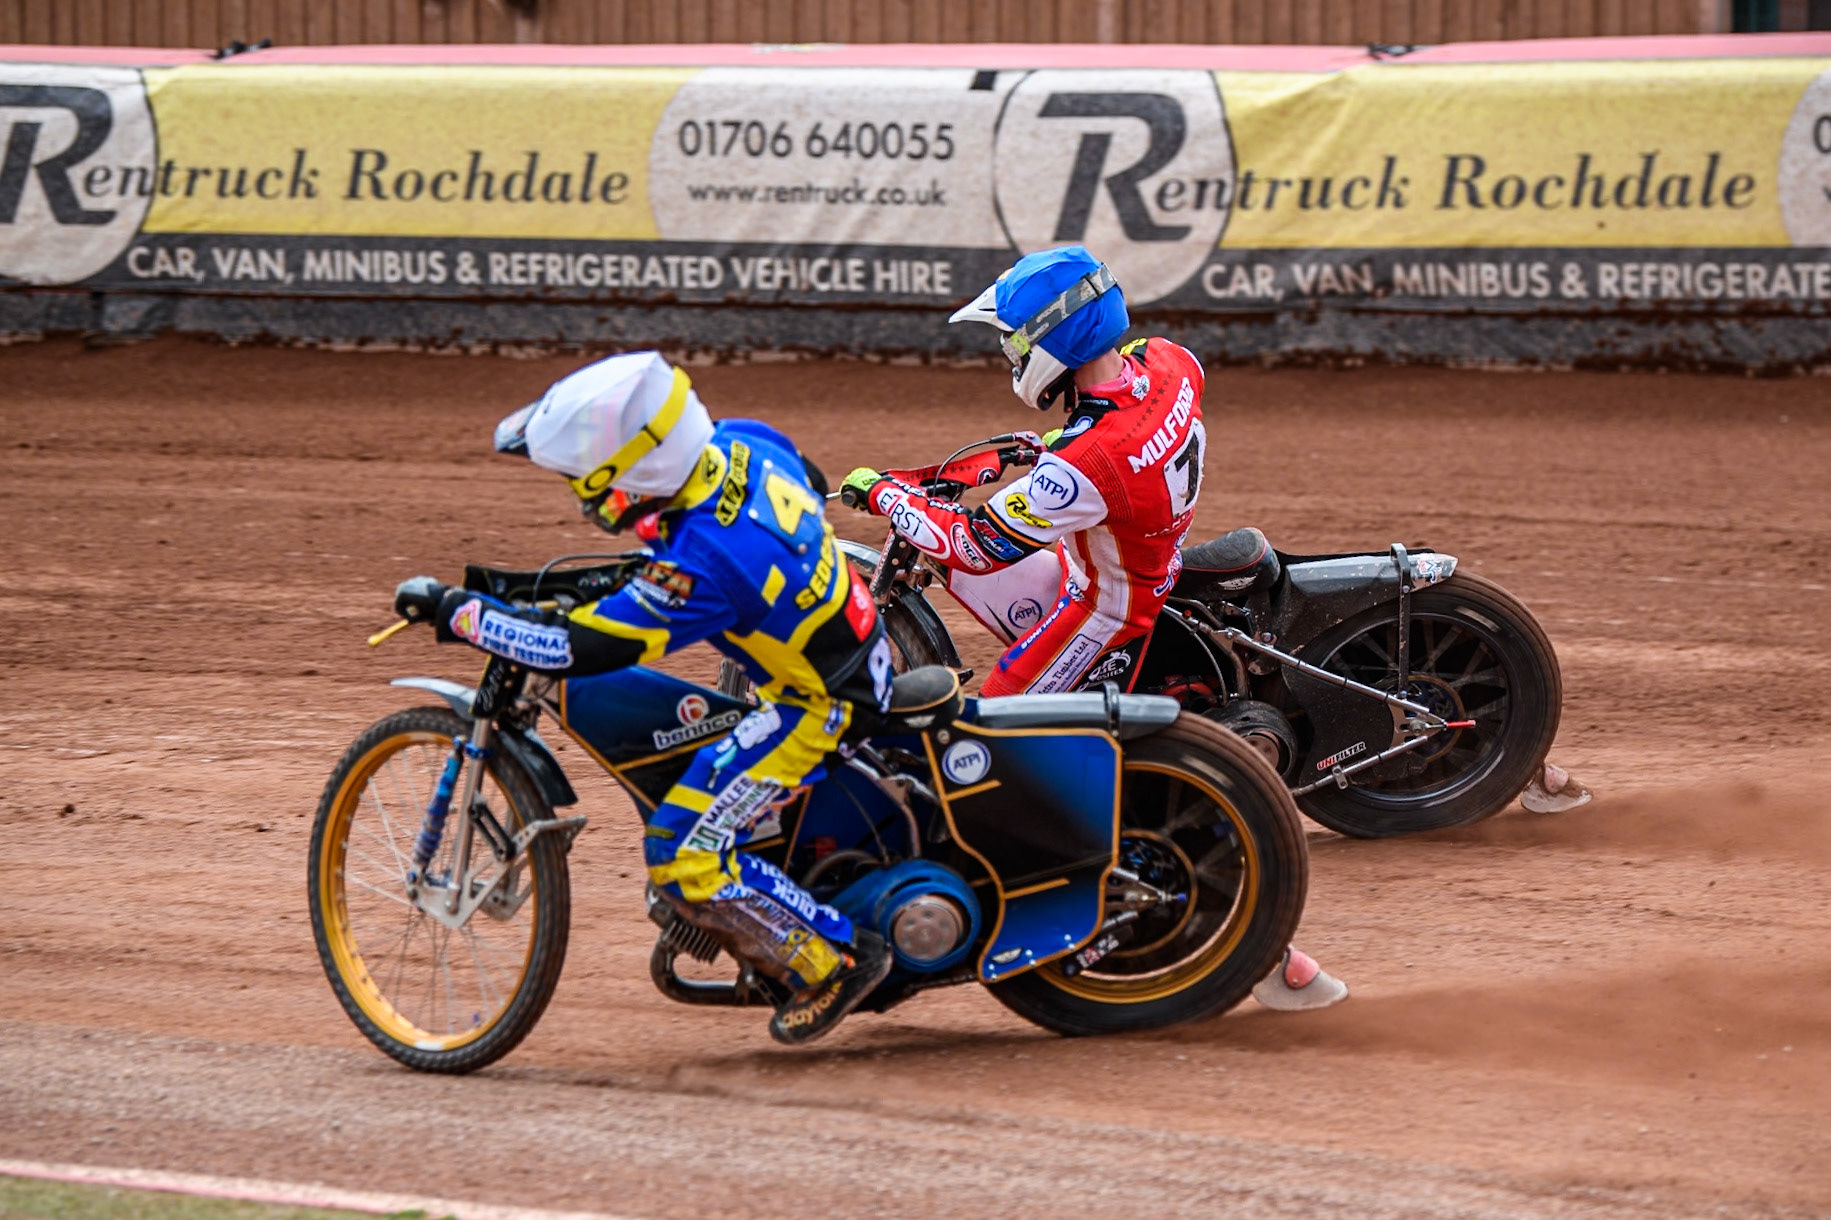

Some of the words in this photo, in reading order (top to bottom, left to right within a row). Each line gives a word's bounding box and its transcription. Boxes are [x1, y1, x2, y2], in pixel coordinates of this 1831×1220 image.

[679, 120, 793, 158] 01706
[806, 121, 954, 162] 640055
[343, 148, 630, 204] Rochdale
[1038, 91, 1410, 243] Rentruck
[1435, 149, 1755, 210] Rochdale
[688, 179, 946, 208] www.rentruck.co.uk
[126, 245, 204, 283] CAR,
[212, 248, 294, 285] VAN,
[303, 249, 447, 284] MINIBUS
[455, 250, 481, 284] &
[488, 251, 724, 290] REFRIGERATED
[729, 256, 864, 292] VEHICLE
[873, 260, 951, 296] HIRE
[1203, 264, 1283, 302] CAR,
[1292, 264, 1386, 300] VAN,
[1399, 263, 1549, 297] MINIBUS
[1561, 263, 1588, 297] &
[764, 472, 819, 536] 4
[1034, 474, 1070, 500] ATPI
[1014, 606, 1037, 622] ATPI
[953, 751, 982, 773] ATPI
[1317, 741, 1366, 771] UNIFILTER
[771, 878, 818, 922] DICK
